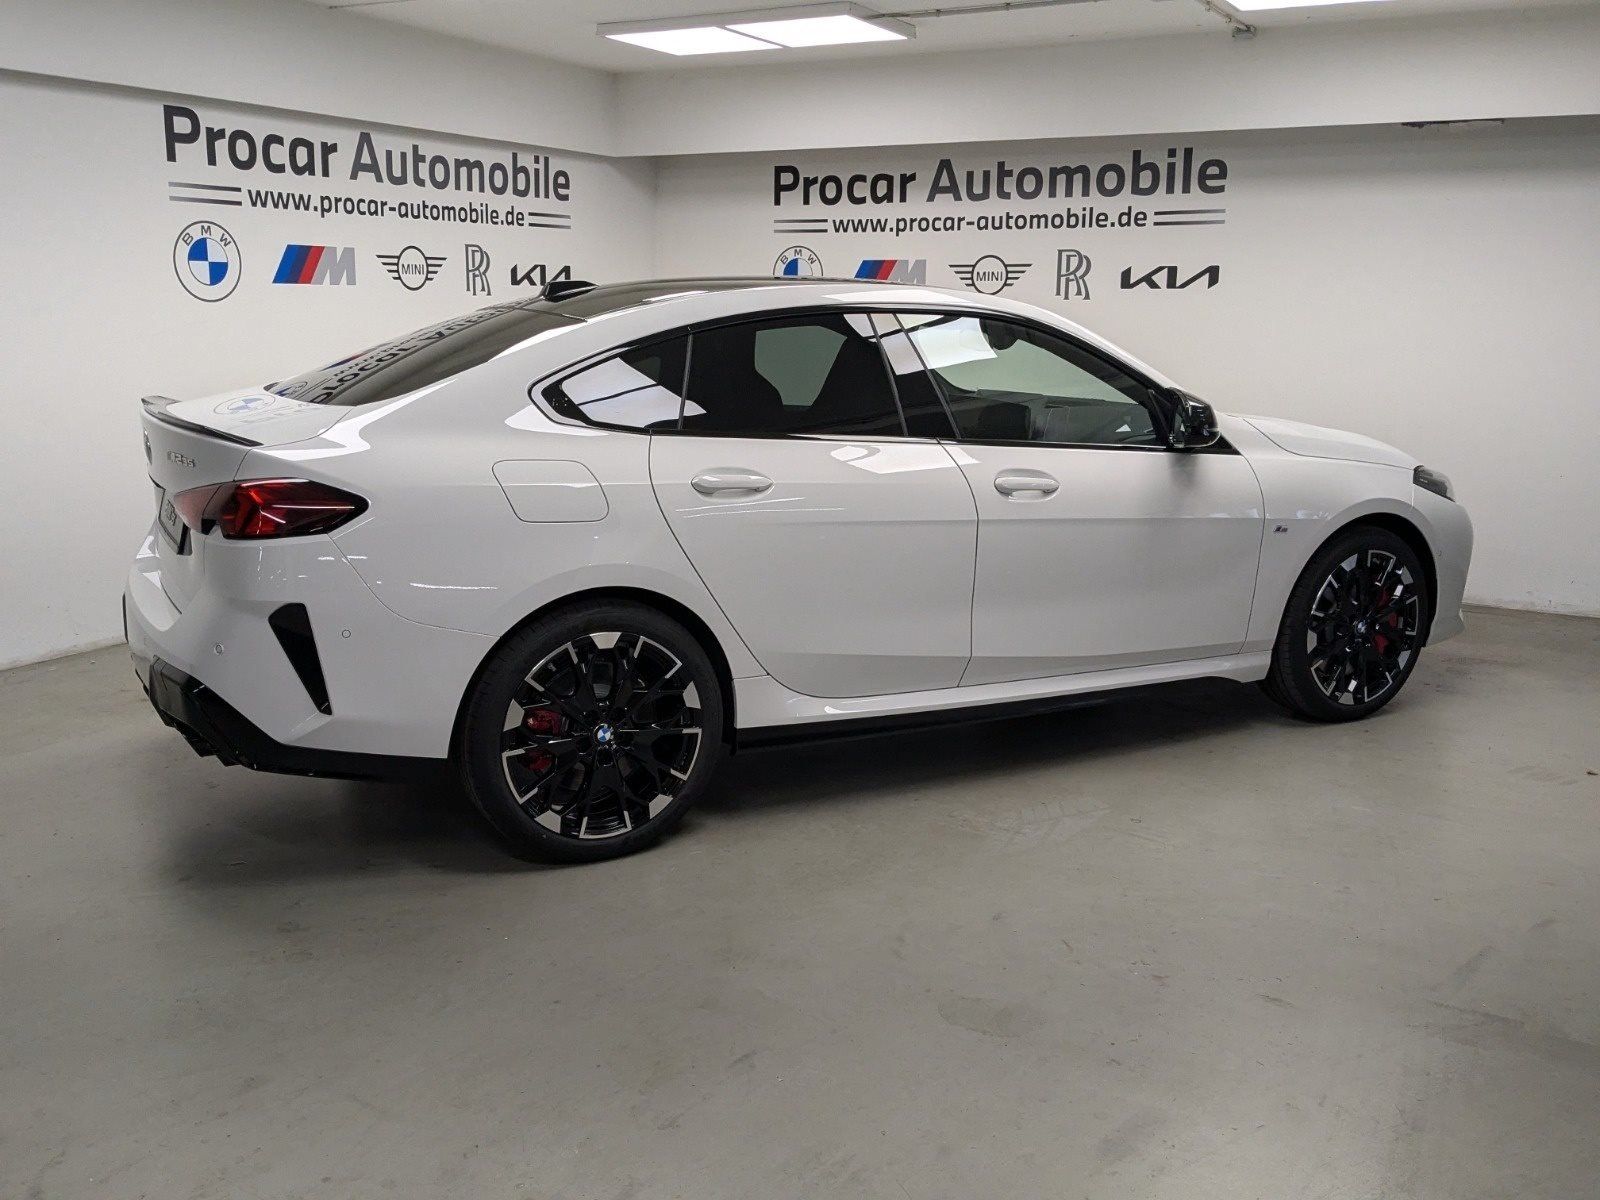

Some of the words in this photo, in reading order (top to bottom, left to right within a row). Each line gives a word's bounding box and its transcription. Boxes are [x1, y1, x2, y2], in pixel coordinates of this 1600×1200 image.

[163, 104, 338, 178] Procar
[350, 132, 571, 201] Automobile
[773, 165, 917, 207] Procar
[926, 147, 1229, 202] Automobile
[248, 188, 526, 228] www.procar-automobile.de
[832, 206, 1148, 237] www.procar-automobile.de
[182, 225, 231, 247] BMW
[401, 263, 425, 275] MINI
[780, 249, 817, 265] BMW
[975, 272, 1003, 283] MINI
